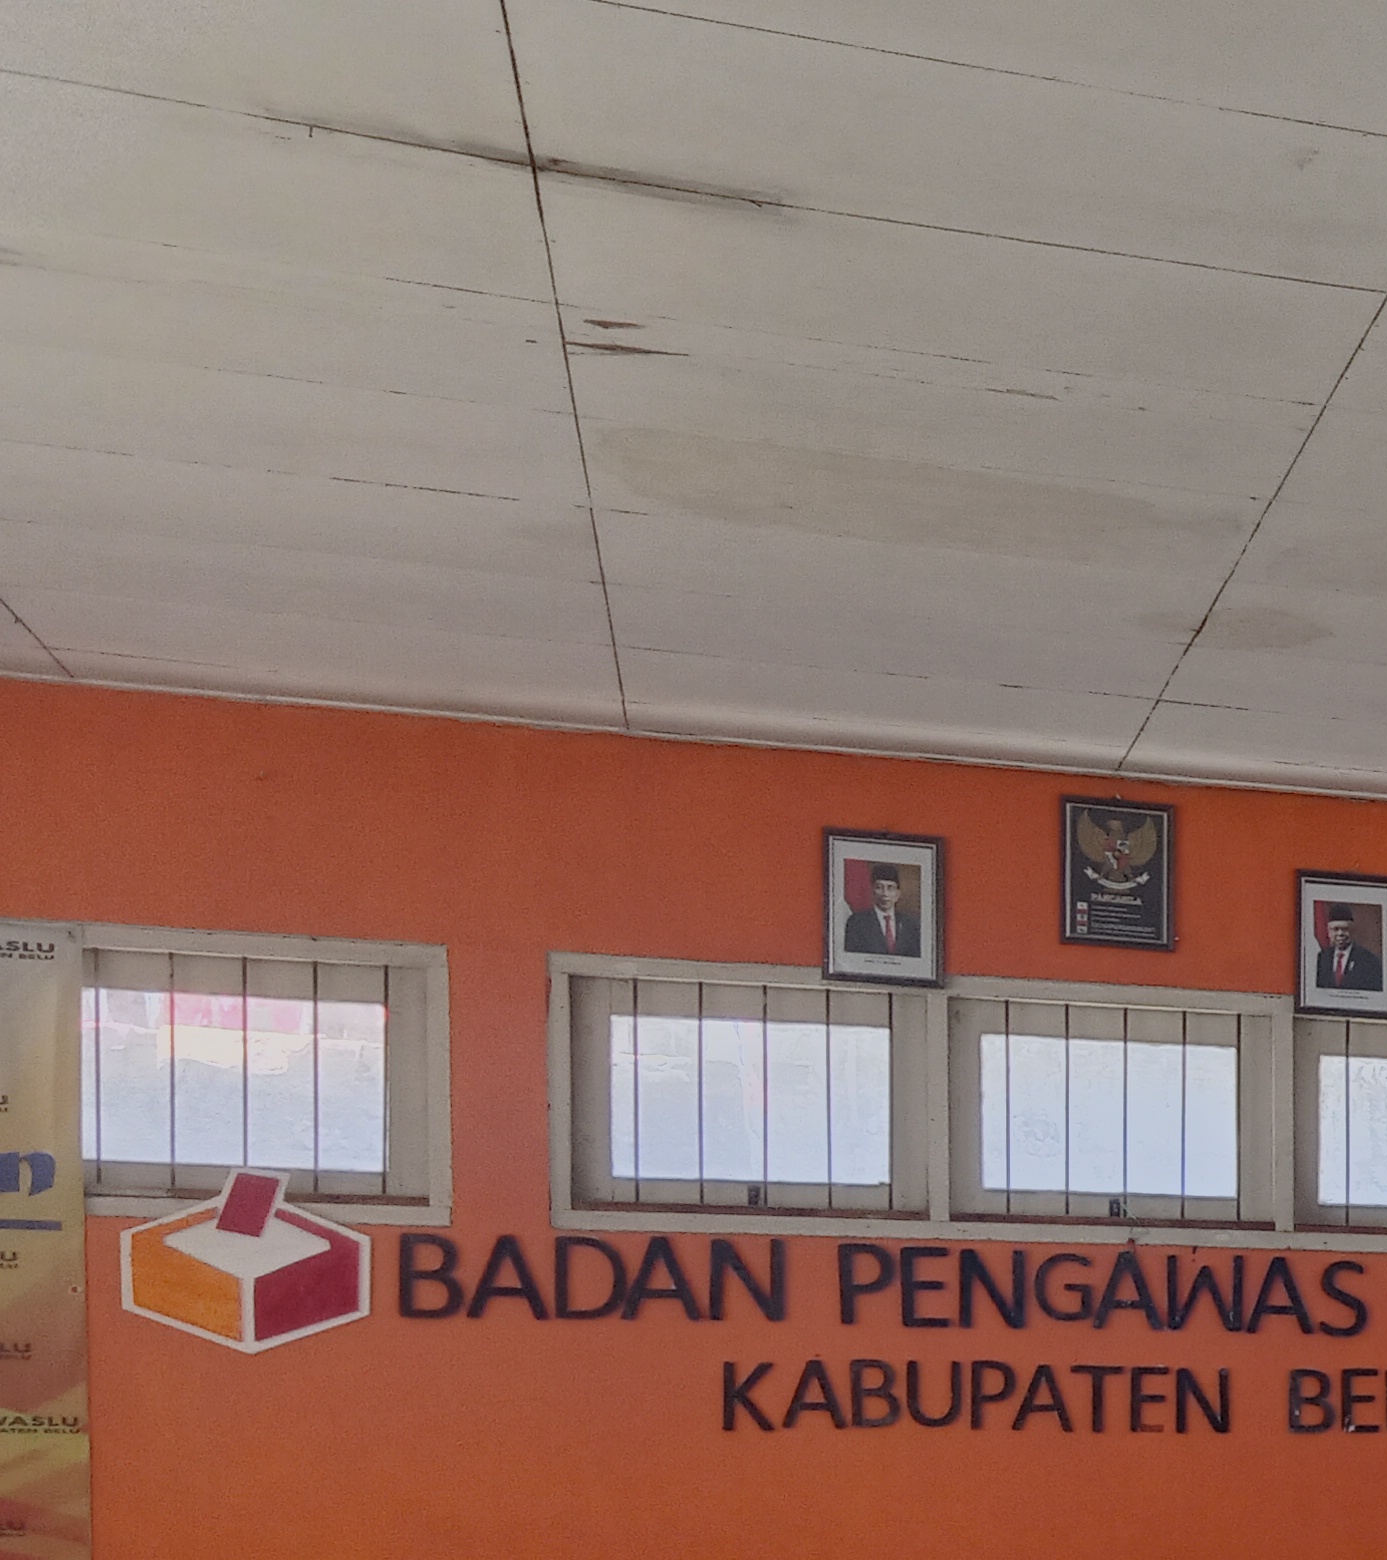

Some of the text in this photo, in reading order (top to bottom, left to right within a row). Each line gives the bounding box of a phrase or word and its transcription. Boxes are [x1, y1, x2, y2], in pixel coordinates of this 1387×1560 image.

[399, 1232, 787, 1322] BADAN
[836, 1243, 1368, 1338] PENGAWAS
[721, 1358, 1230, 1434] KABUPATEN
